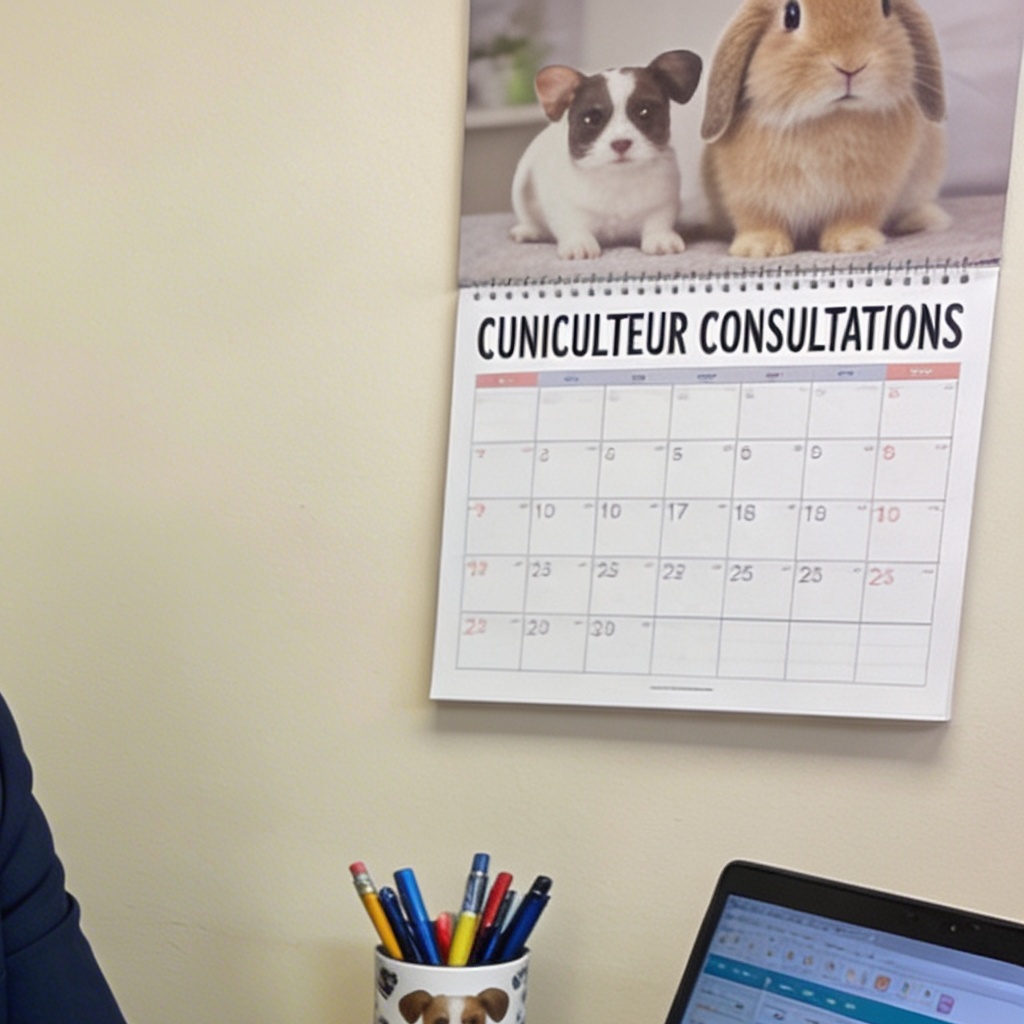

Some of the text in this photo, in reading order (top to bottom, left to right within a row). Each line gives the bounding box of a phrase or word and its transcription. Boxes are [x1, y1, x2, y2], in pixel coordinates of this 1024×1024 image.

[477, 303, 964, 360] CUNICULTEUR CONSULTATIONS
[536, 503, 556, 519] 10
[601, 503, 621, 519] 10
[668, 503, 689, 521] 17
[877, 506, 901, 522] 10
[729, 564, 754, 582] 25
